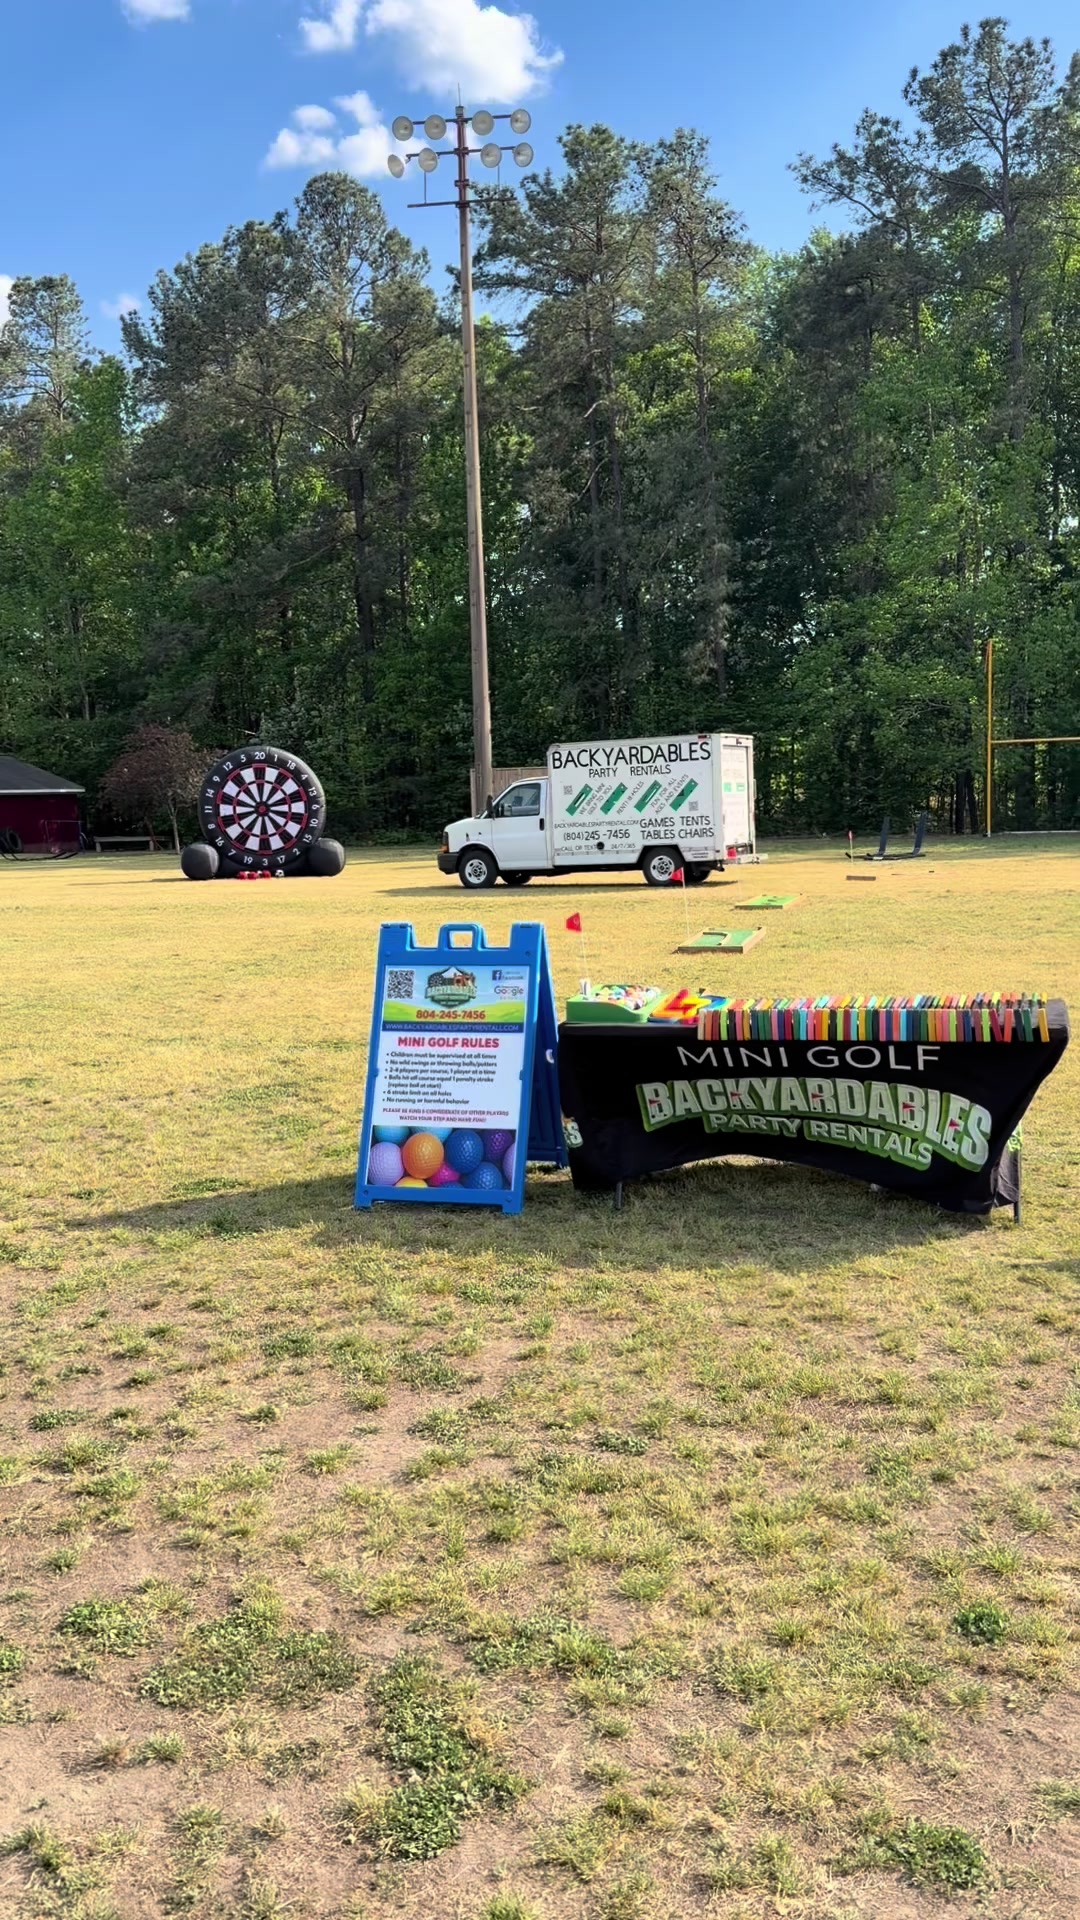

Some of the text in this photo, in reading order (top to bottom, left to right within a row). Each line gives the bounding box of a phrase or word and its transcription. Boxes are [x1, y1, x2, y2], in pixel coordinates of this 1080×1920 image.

[240, 754, 246, 762] 5
[254, 752, 266, 760] 20
[274, 754, 278, 762] 1
[551, 742, 712, 769] BACKYARDABLES
[222, 762, 233, 771] 12
[286, 760, 296, 770] 18
[589, 764, 671, 778] PARTY RENTALS
[205, 788, 214, 798] 14
[308, 787, 317, 796] 13
[310, 818, 318, 826] 10
[640, 815, 711, 828] GAMES TENTS
[640, 827, 714, 839] TABLES CHAIRS
[215, 836, 224, 846] 16
[302, 834, 312, 843] 15
[228, 848, 236, 856] 7
[292, 848, 300, 856] 2
[244, 856, 253, 864] 19
[262, 858, 268, 866] 3
[276, 855, 286, 864] 17
[494, 985, 524, 997] Google
[416, 1010, 486, 1020] 804-245-7456
[397, 1036, 500, 1048] MINI GOLF RULES
[676, 1045, 941, 1071] MINI GOLF
[638, 1077, 992, 1168] BACKYARDABLES
[706, 1113, 934, 1166] PARTY RENTALS
